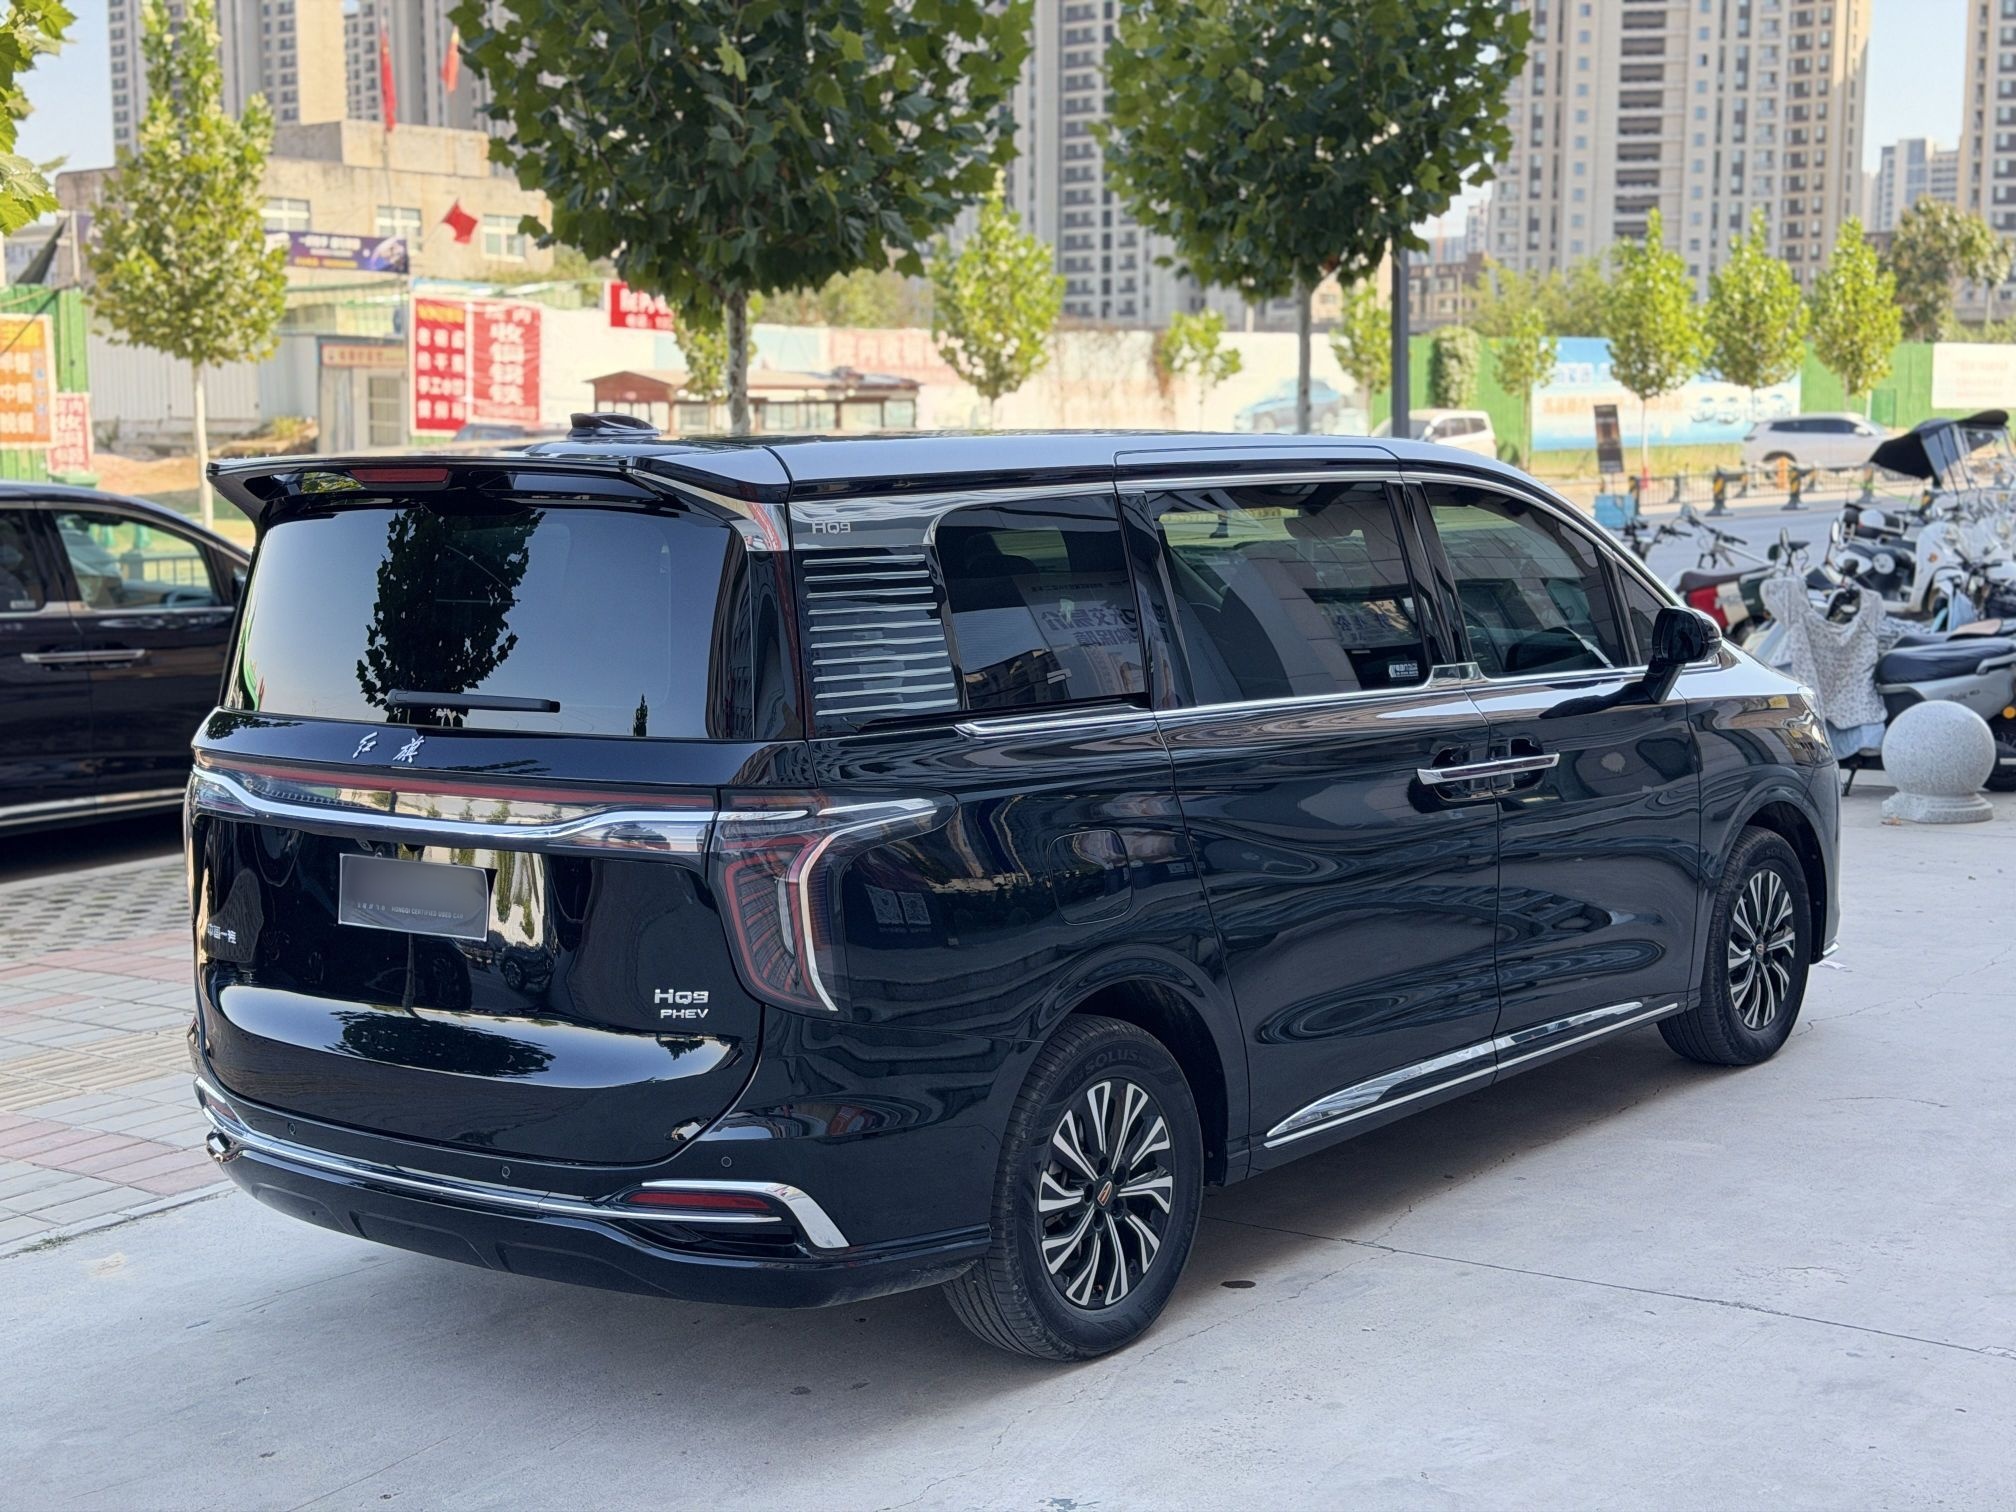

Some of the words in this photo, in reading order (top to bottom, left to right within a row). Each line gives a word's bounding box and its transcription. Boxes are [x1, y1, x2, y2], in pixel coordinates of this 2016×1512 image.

[811, 521, 851, 534] HQ9
[352, 731, 424, 764] 红旗
[654, 988, 709, 1005] HQ9
[660, 1008, 709, 1019] PHEV
